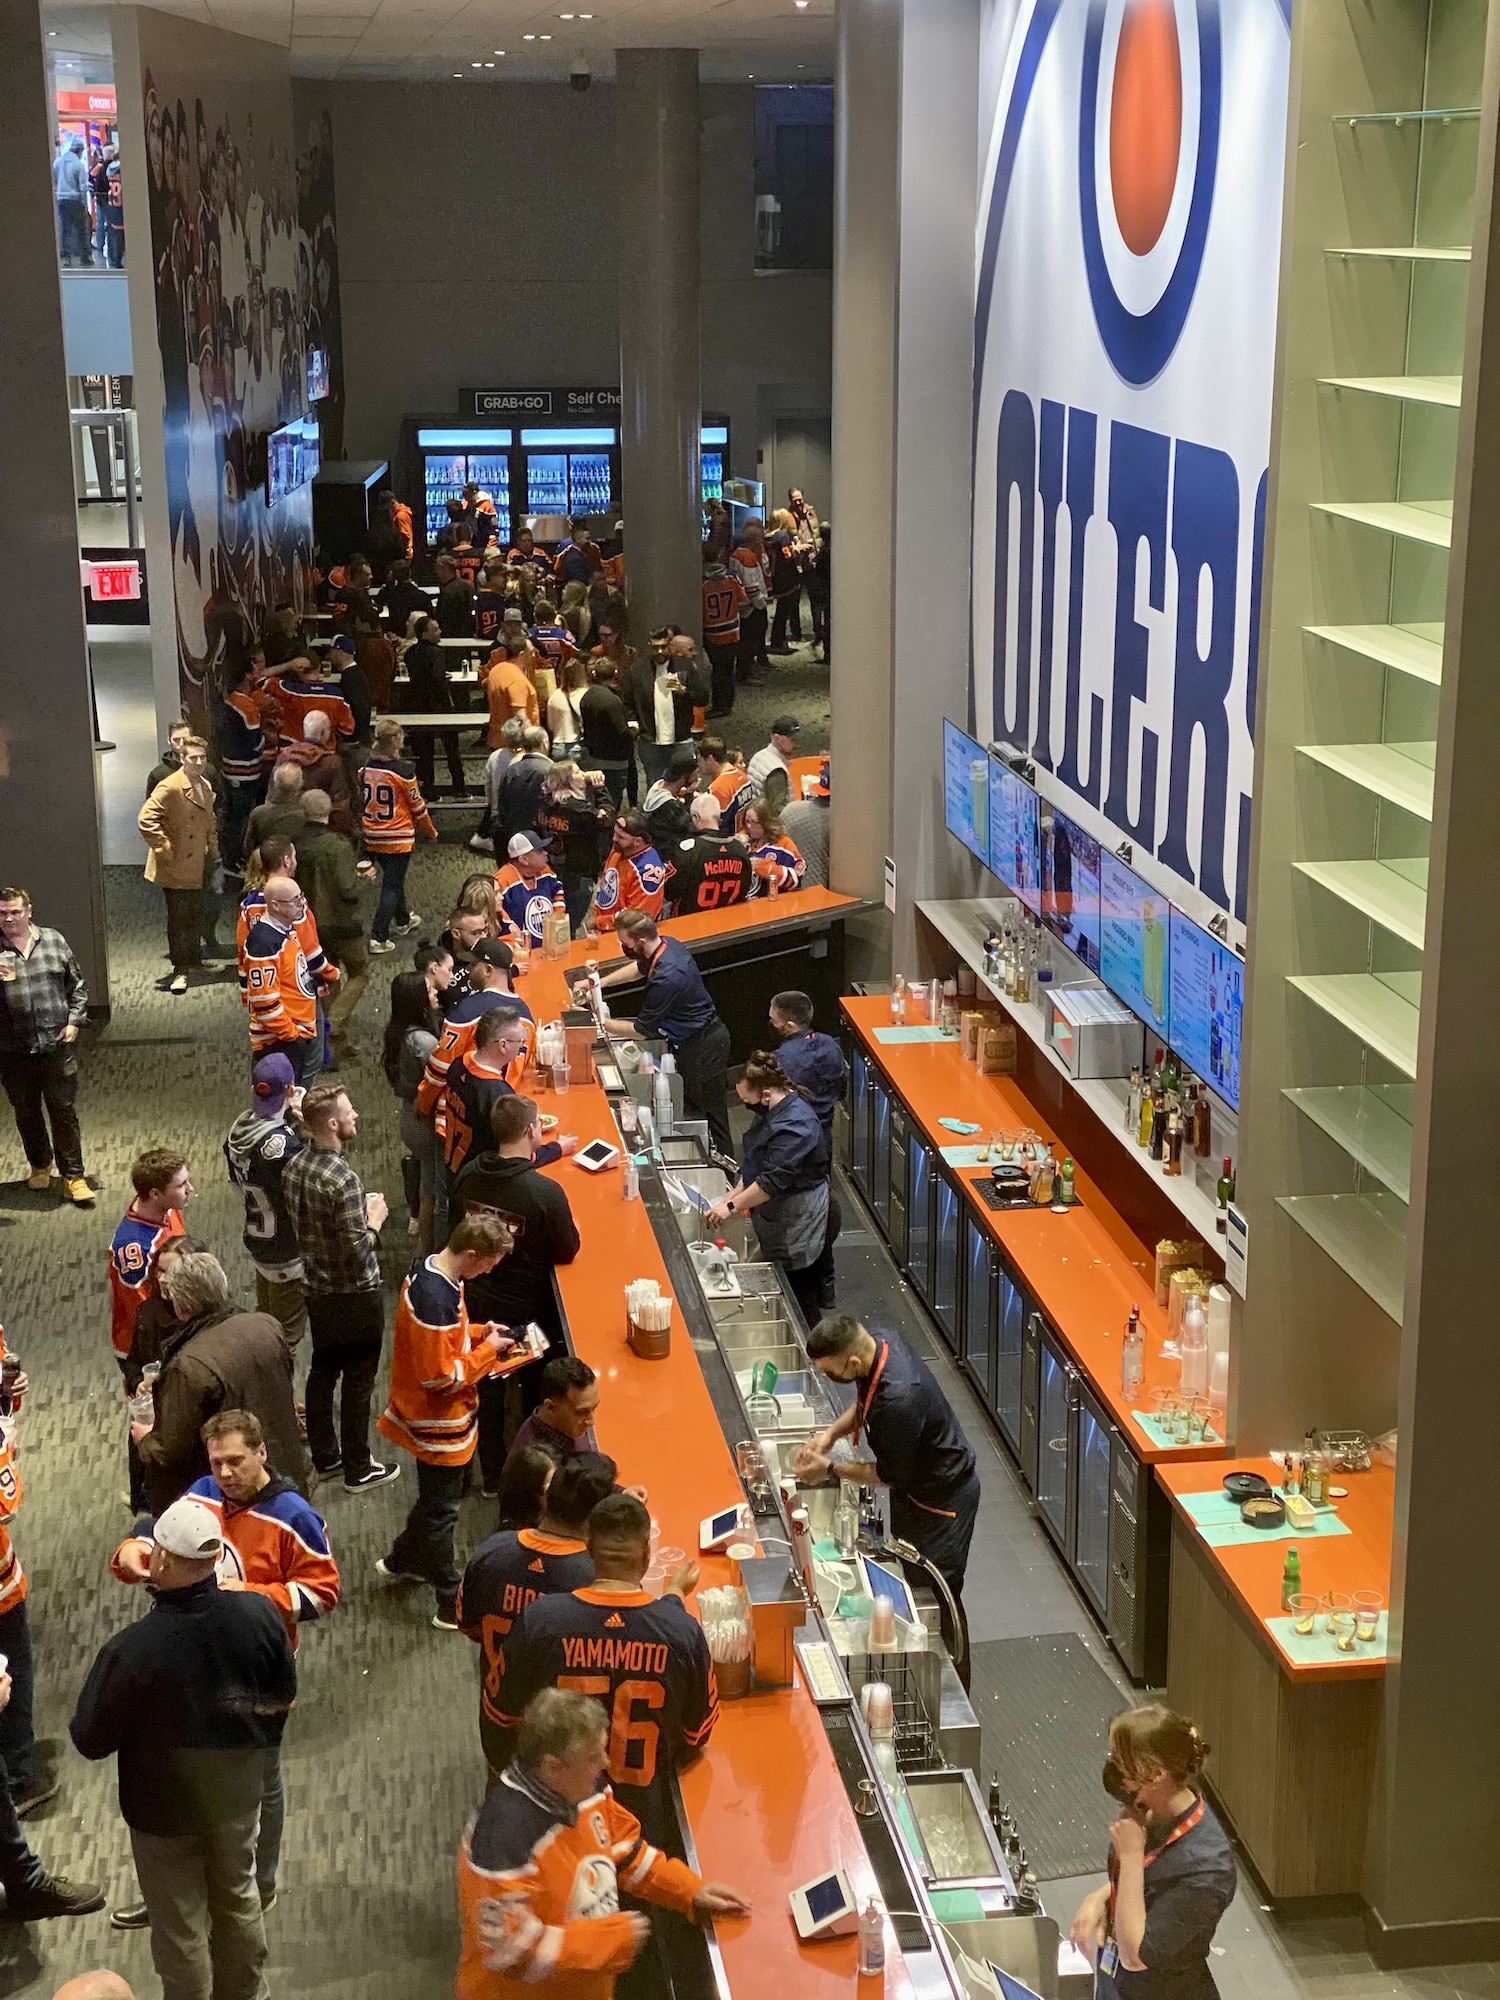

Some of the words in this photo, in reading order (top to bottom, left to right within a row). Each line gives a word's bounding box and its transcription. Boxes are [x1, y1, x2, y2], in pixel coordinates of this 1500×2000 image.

[483, 397, 544, 409] GRAB+GO
[567, 392, 595, 405] Self
[98, 572, 131, 597] EXIT
[706, 588, 733, 621] 97
[642, 863, 664, 884] 29
[703, 859, 743, 876] McDAVID
[697, 880, 742, 909] 97
[249, 965, 277, 990] 97
[118, 1242, 144, 1274] 19
[561, 1637, 669, 1674] YAMAMOTO
